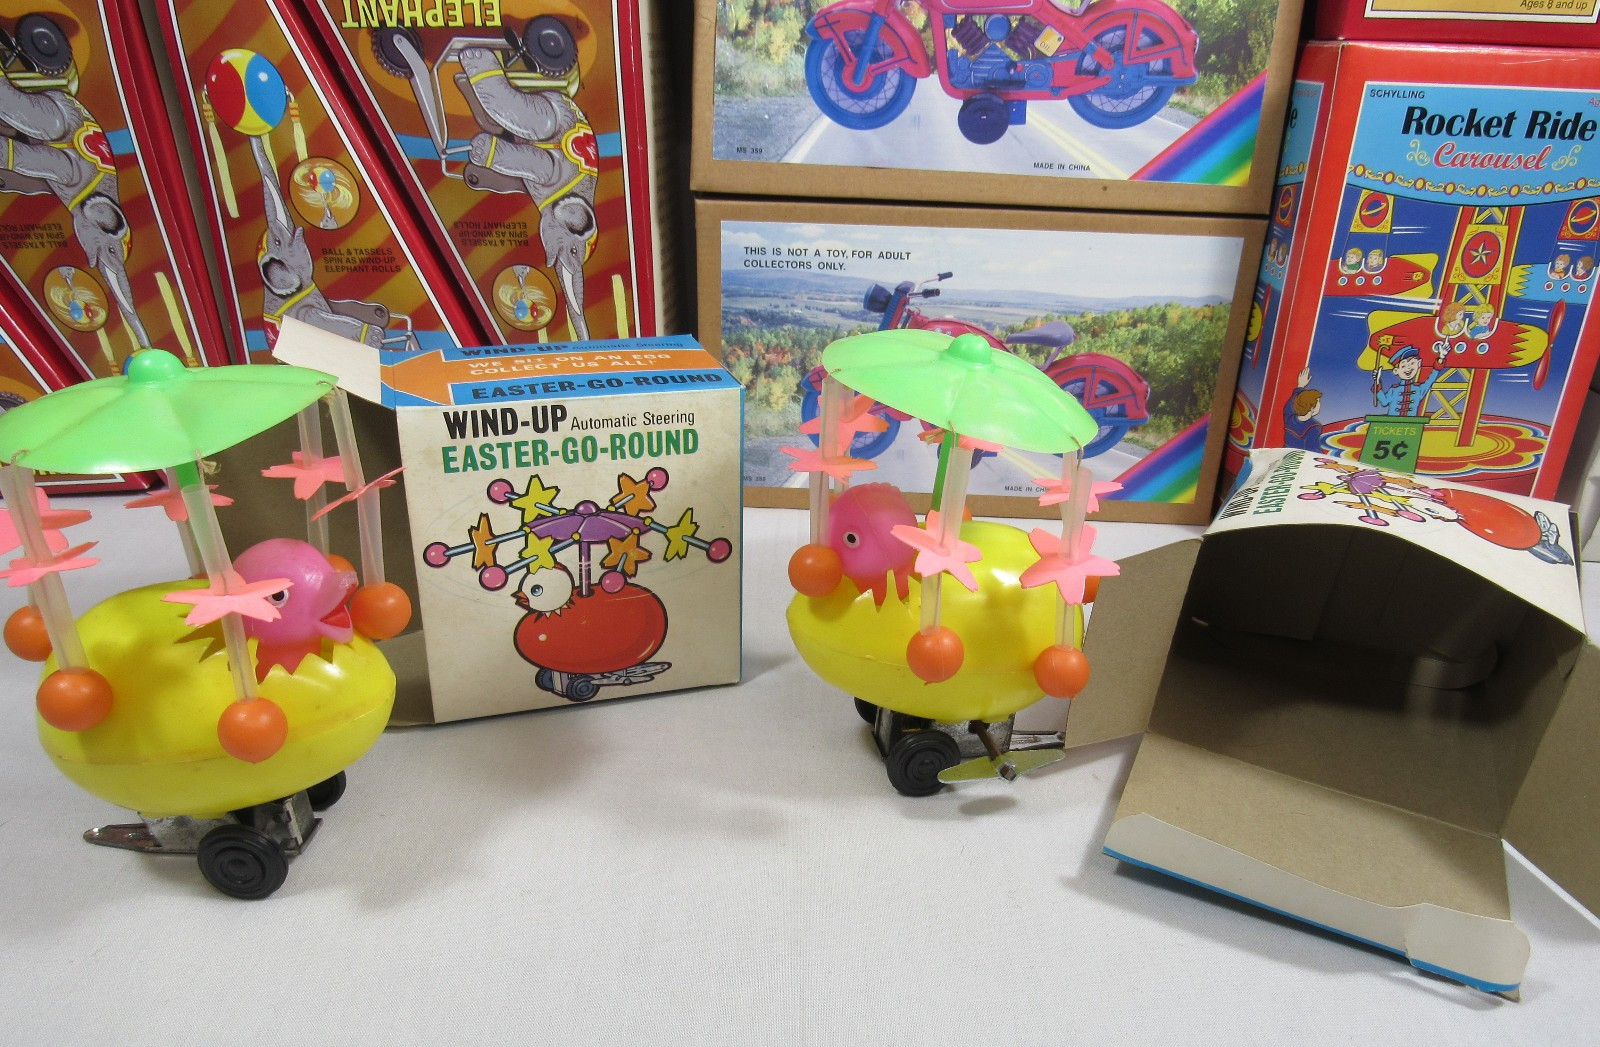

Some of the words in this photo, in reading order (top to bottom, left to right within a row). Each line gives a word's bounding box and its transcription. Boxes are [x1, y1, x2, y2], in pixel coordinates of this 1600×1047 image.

[1520, 0, 1544, 10] Ages
[1555, 0, 1573, 9] and
[1575, 2, 1588, 11] up
[341, 0, 502, 28] ELEPHANT
[1370, 89, 1425, 99] SCHYLLING
[1401, 106, 1517, 138] Rocket
[1525, 110, 1598, 141] Ride
[736, 146, 747, 154] MS
[1433, 141, 1552, 171] Carousel
[1033, 162, 1054, 170] MADE
[20, 223, 62, 231] ELEPHANT
[453, 221, 481, 229] ROLLS
[46, 231, 65, 239] SPIN
[48, 240, 68, 249] BALL
[461, 239, 498, 247] TASSELS
[509, 239, 529, 247] BALL
[322, 248, 344, 256] BALL
[346, 248, 352, 256] &
[354, 248, 393, 256] TASSELS
[743, 246, 767, 255] THIS
[772, 247, 782, 256] IS
[787, 248, 809, 257] NOT
[813, 249, 821, 257] A
[826, 249, 848, 259] TOY,
[851, 250, 873, 259] FOR
[877, 251, 912, 260] ADULT
[323, 256, 344, 264] SPIN
[345, 256, 357, 264] AS
[358, 256, 396, 264] WIND-UP
[743, 259, 812, 269] COLLECTORS
[817, 261, 846, 271] ONLY.
[325, 265, 369, 273] ELEPHANT
[372, 265, 401, 273] ROLLS
[461, 344, 568, 357] WIND-UP
[468, 361, 502, 369] WE
[555, 354, 583, 362] ON
[470, 363, 561, 375] COLLECT
[472, 372, 723, 400] EASTER-GO-ROUND
[443, 404, 568, 440] WIND-UP
[570, 413, 637, 431] Automatic
[643, 409, 695, 426] Steering
[1373, 426, 1417, 436] TICKETS
[441, 428, 699, 474] EASTER-GO-ROUND
[1373, 440, 1408, 460] 5¢
